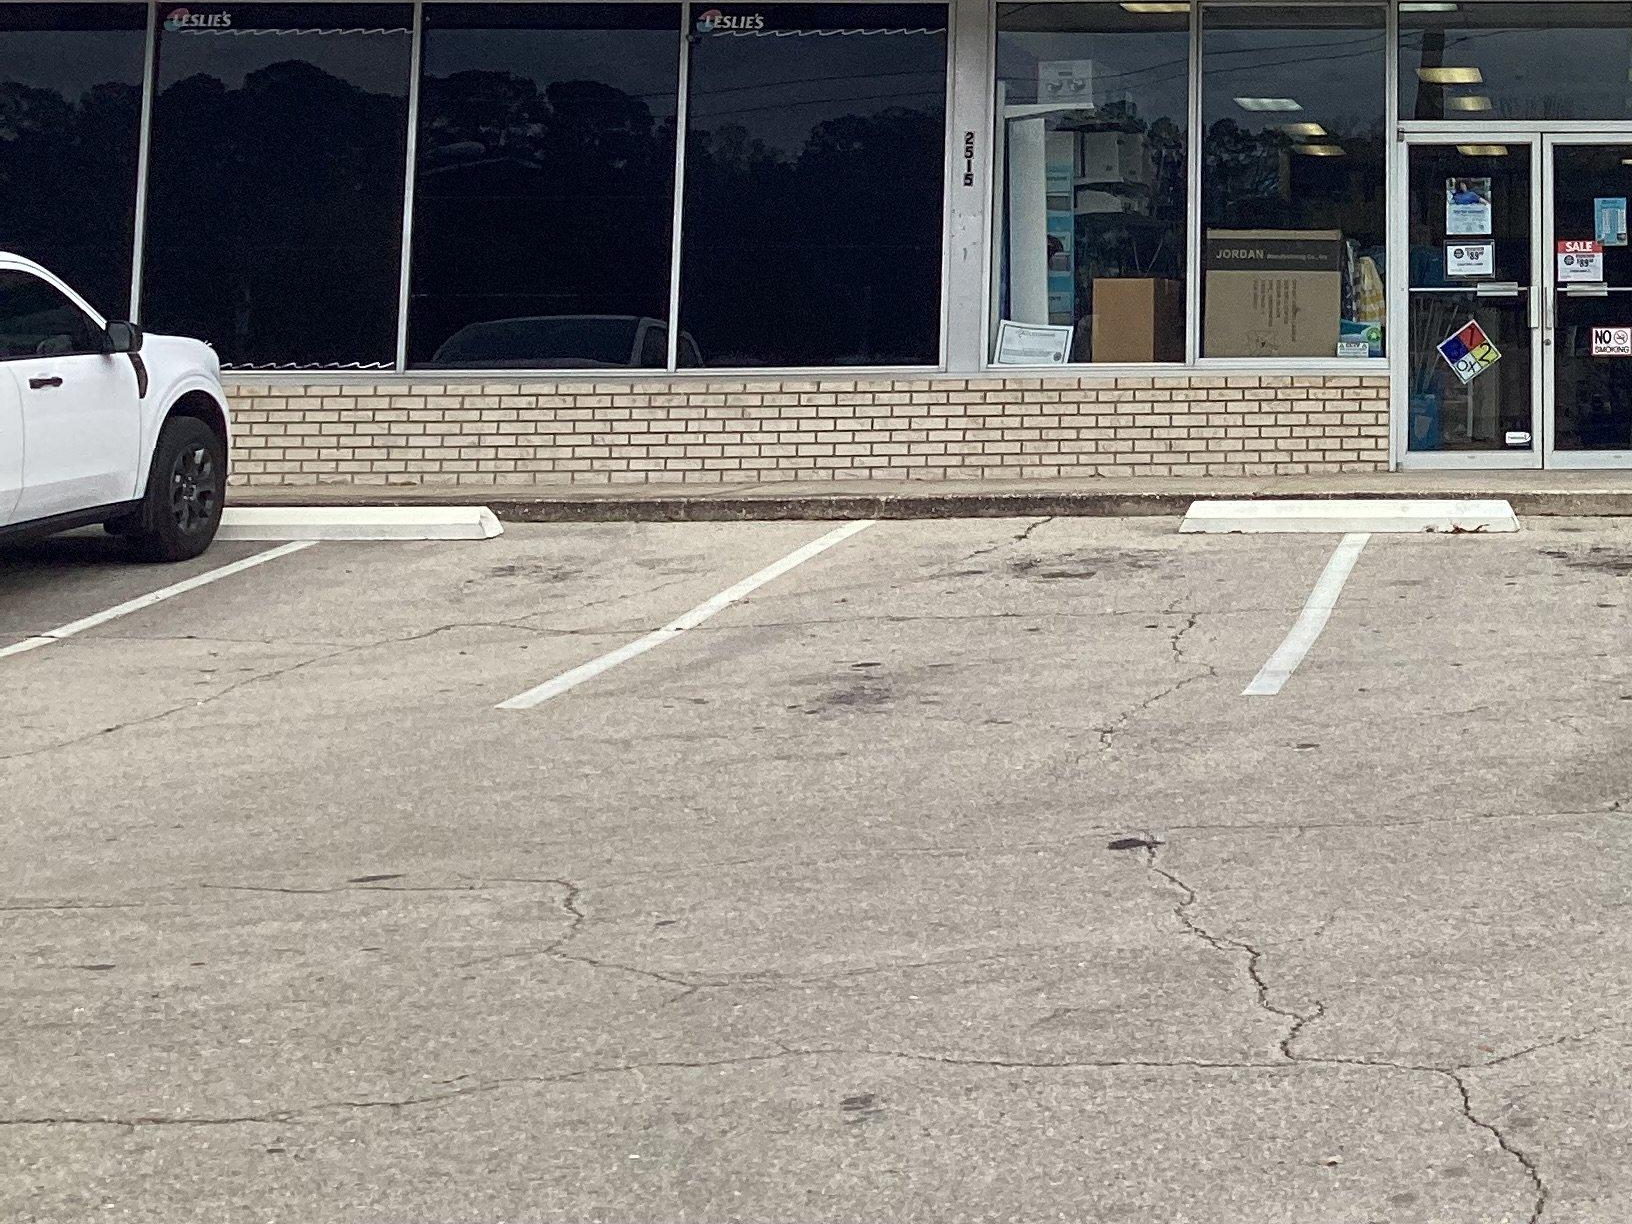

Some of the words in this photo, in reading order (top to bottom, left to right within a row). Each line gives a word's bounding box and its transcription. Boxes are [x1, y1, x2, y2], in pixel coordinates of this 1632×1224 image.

[172, 11, 231, 27] LESLIE'S
[705, 13, 764, 29] LESLIE'S
[1565, 241, 1593, 252] SALE
[1216, 249, 1264, 259] JORDAN
[1595, 330, 1611, 344] NO
[1478, 342, 1492, 364] 2
[1595, 346, 1629, 354] SMOKING
